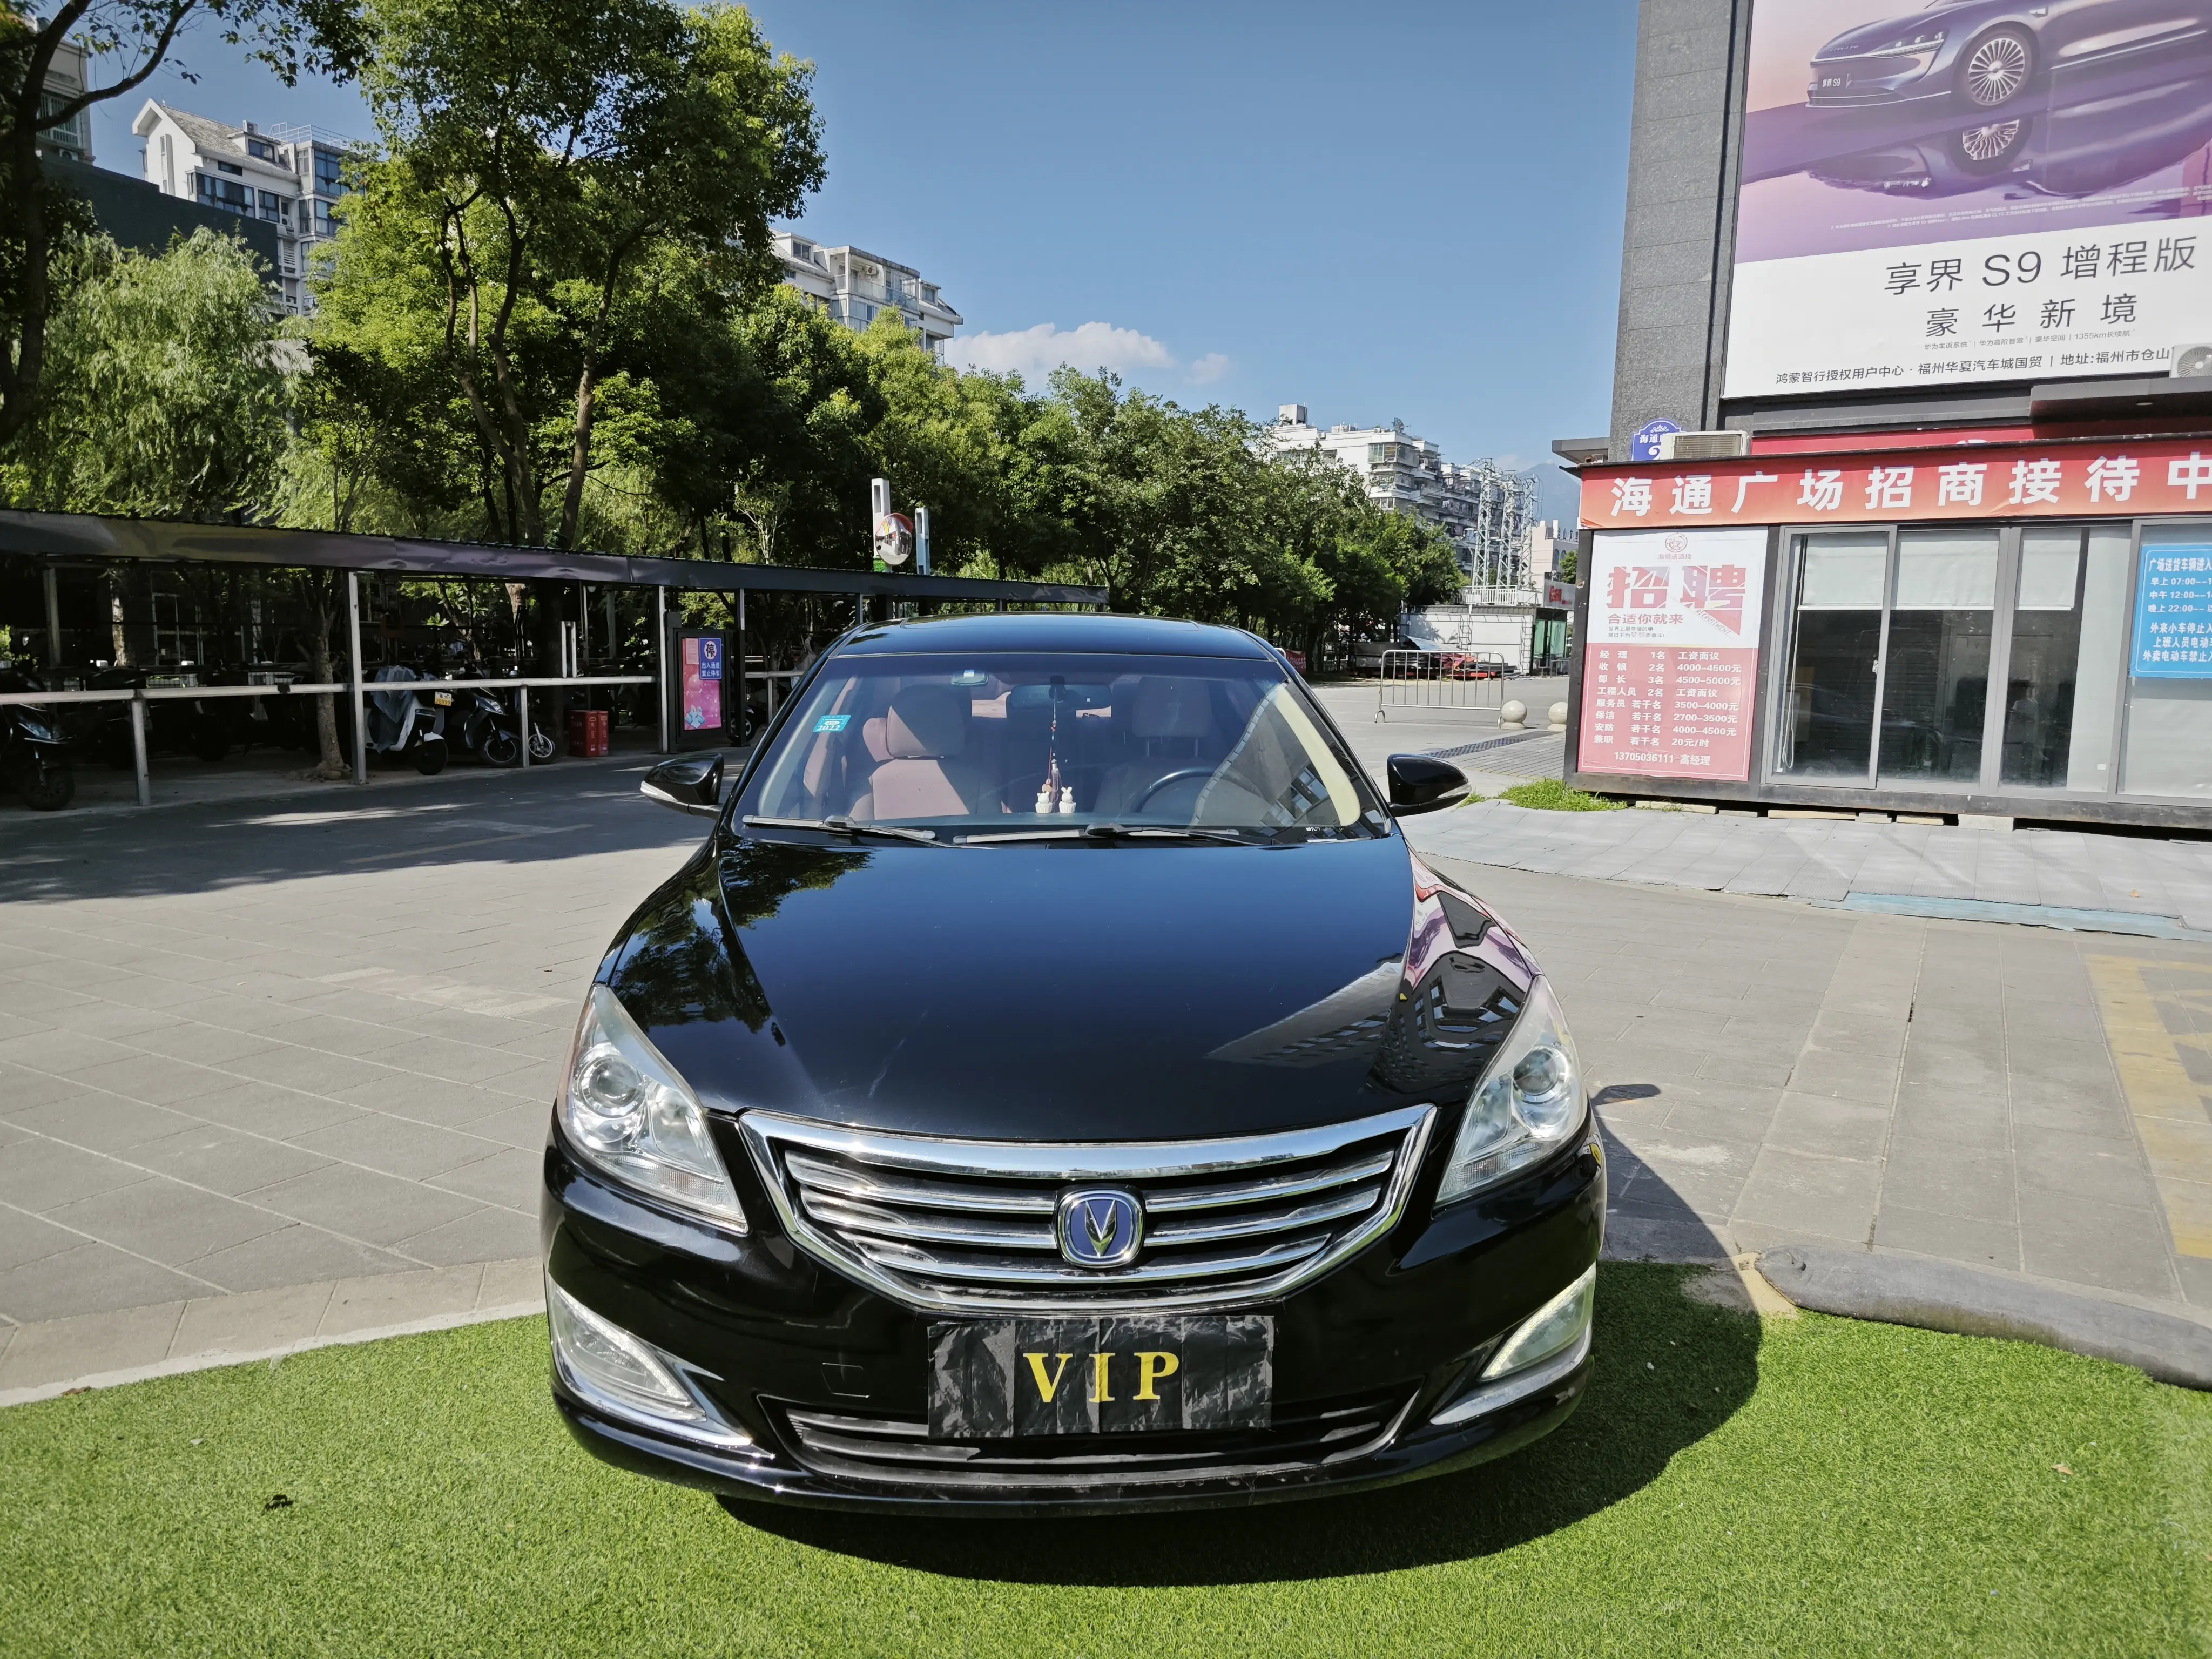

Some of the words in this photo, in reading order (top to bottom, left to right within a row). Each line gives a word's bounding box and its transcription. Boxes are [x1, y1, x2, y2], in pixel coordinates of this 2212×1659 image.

[1833, 78, 1841, 87] S9
[1884, 258, 1963, 295] 享界
[1982, 251, 2042, 287] S9
[2060, 235, 2197, 280] 增程版
[1925, 293, 2138, 338] 豪华新境
[2035, 334, 2066, 343] 豪华空间
[1610, 451, 2212, 517] 海通广场招商接待中
[2150, 577, 2168, 586] 早上
[2149, 590, 2167, 599] 中午
[1606, 564, 1746, 636] 招聘
[2148, 604, 2166, 613] 晚上
[1608, 613, 1683, 624] 合适你就来
[1600, 650, 1628, 659] 经理
[1651, 651, 1665, 659] 1名
[1677, 651, 1719, 660] 工资面议
[1599, 662, 1627, 671] 收银
[1649, 663, 1664, 672] 2名
[1598, 675, 1626, 683] 部长
[1648, 676, 1664, 684] 3名
[1597, 687, 1636, 696] 工程人员
[1648, 688, 1663, 697] 2名
[1676, 689, 1717, 698] 工资面议
[1596, 699, 1626, 708] 服务员
[1631, 700, 1661, 709] 若干名
[1595, 711, 1615, 719] 保洁
[1631, 712, 1661, 721] 若干名
[1595, 723, 1614, 732] 安防
[1630, 724, 1661, 734] 若干名
[1630, 737, 1660, 746] 若干名
[1671, 738, 1709, 747] 20元/时
[1614, 751, 1674, 763] 13705036111
[1680, 754, 1710, 765] 高经理
[1022, 1351, 1179, 1404] VIP
